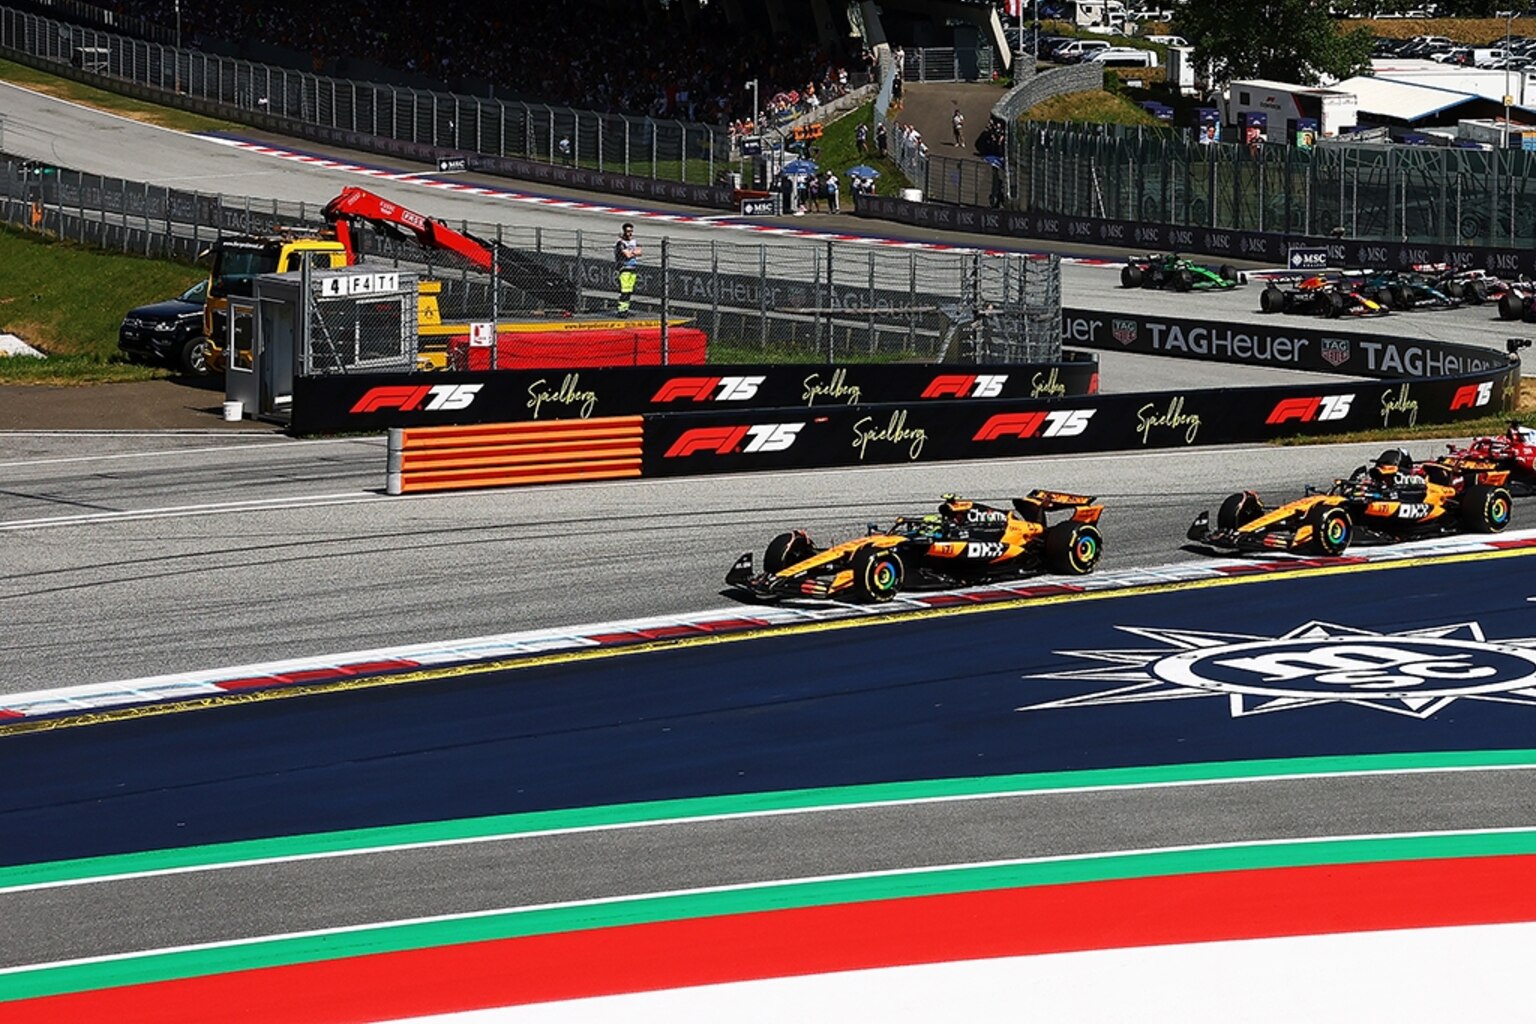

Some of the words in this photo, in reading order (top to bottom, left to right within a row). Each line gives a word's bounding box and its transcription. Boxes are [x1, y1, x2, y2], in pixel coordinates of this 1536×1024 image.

[1107, 225, 1123, 238] MSC
[1142, 228, 1158, 241] MSC
[1176, 231, 1192, 244] MSC
[1212, 234, 1231, 248] MSC
[1249, 238, 1266, 252] MSC
[1302, 253, 1327, 263] MSC
[1368, 247, 1387, 261] MSC
[1408, 249, 1429, 264] MSC
[1452, 252, 1474, 267] MSC
[1497, 255, 1518, 269] MSC
[331, 279, 339, 294] 4
[1324, 340, 1348, 350] TAG
[802, 367, 863, 407] Spielberg
[527, 373, 599, 419] Spielberg
[1136, 396, 1202, 444] Spielberg
[852, 409, 928, 460] Spielberg
